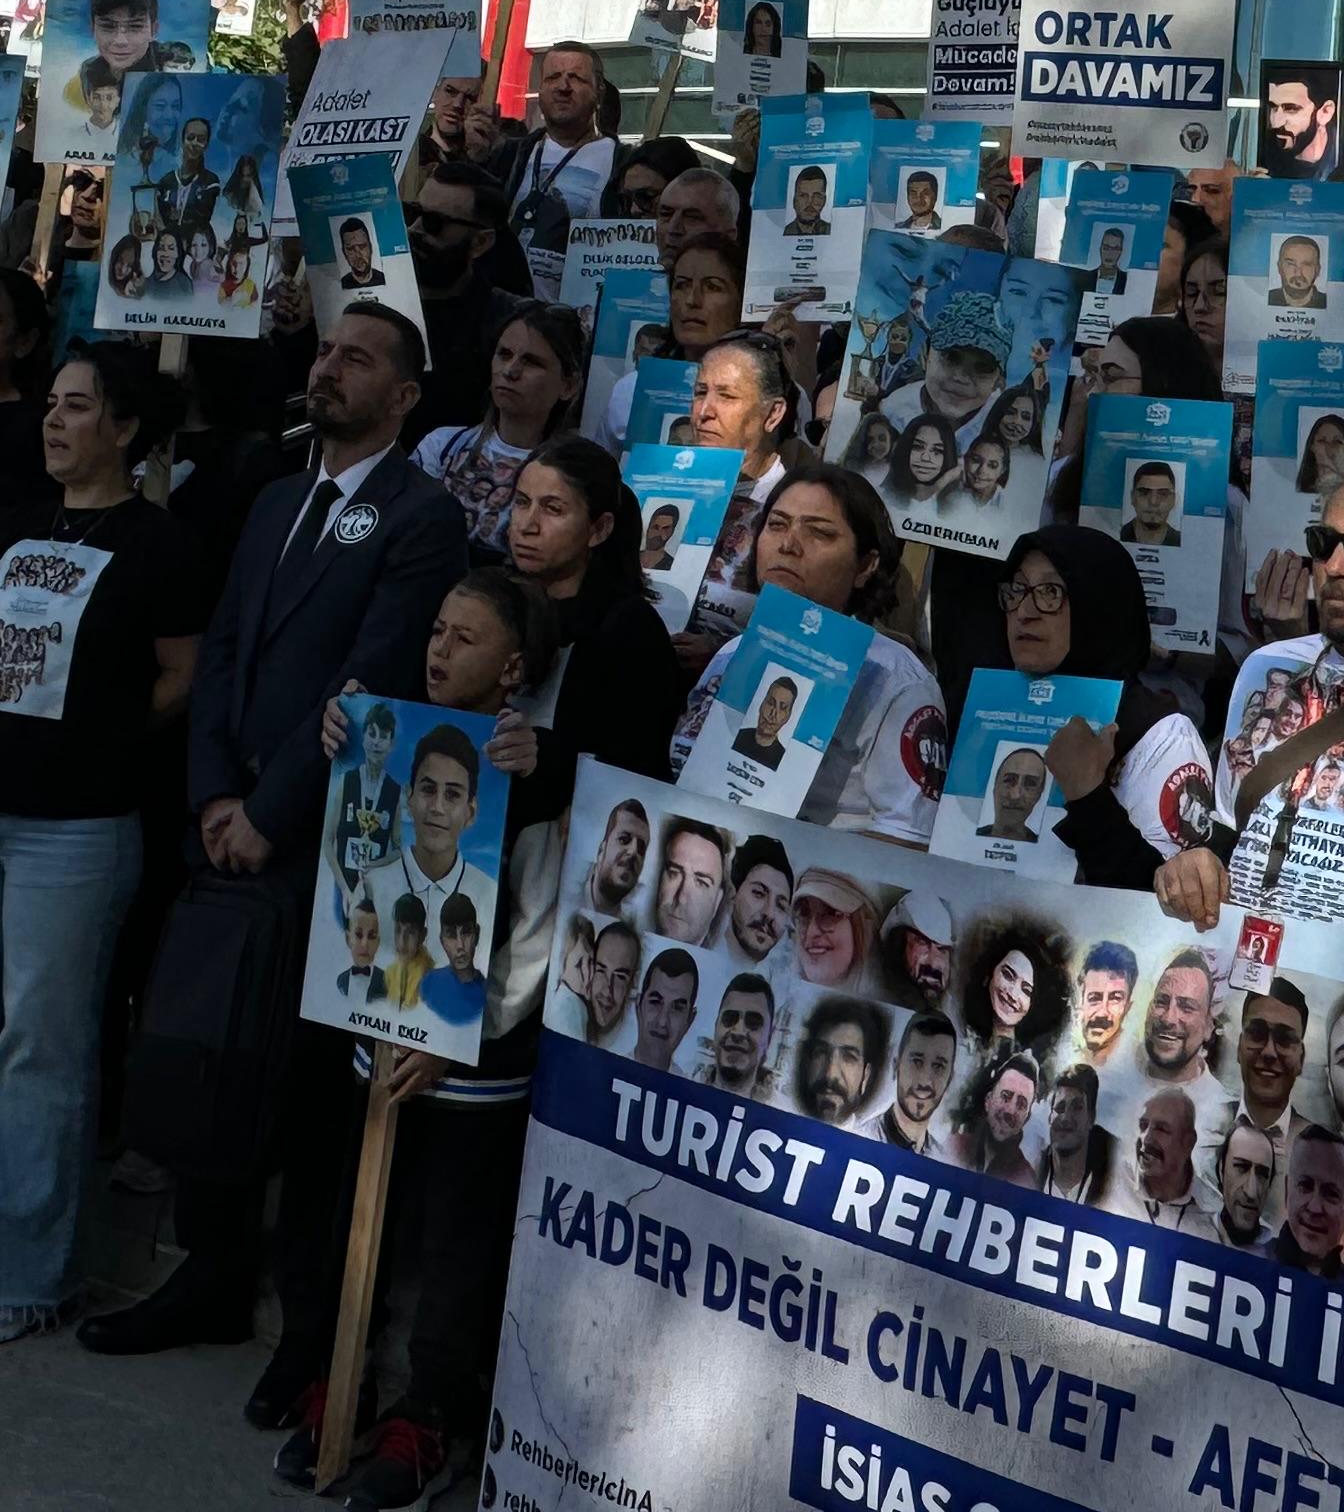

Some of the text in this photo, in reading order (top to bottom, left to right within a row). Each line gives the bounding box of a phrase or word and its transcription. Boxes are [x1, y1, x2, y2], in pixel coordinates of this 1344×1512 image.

[935, 20, 1001, 38] Adalet
[1034, 10, 1174, 50] ORTAK
[934, 45, 1018, 65] Mücade
[1029, 58, 1216, 102] DAVAMIZ
[311, 89, 371, 112] Adalet
[299, 116, 410, 147] OLASI KAST
[611, 1077, 827, 1206] TURİST
[832, 1158, 1294, 1368] REHBERLERİ
[538, 1175, 692, 1297] KADER
[702, 1239, 850, 1366] DEĞİL
[866, 1305, 1137, 1463] CİNAYET
